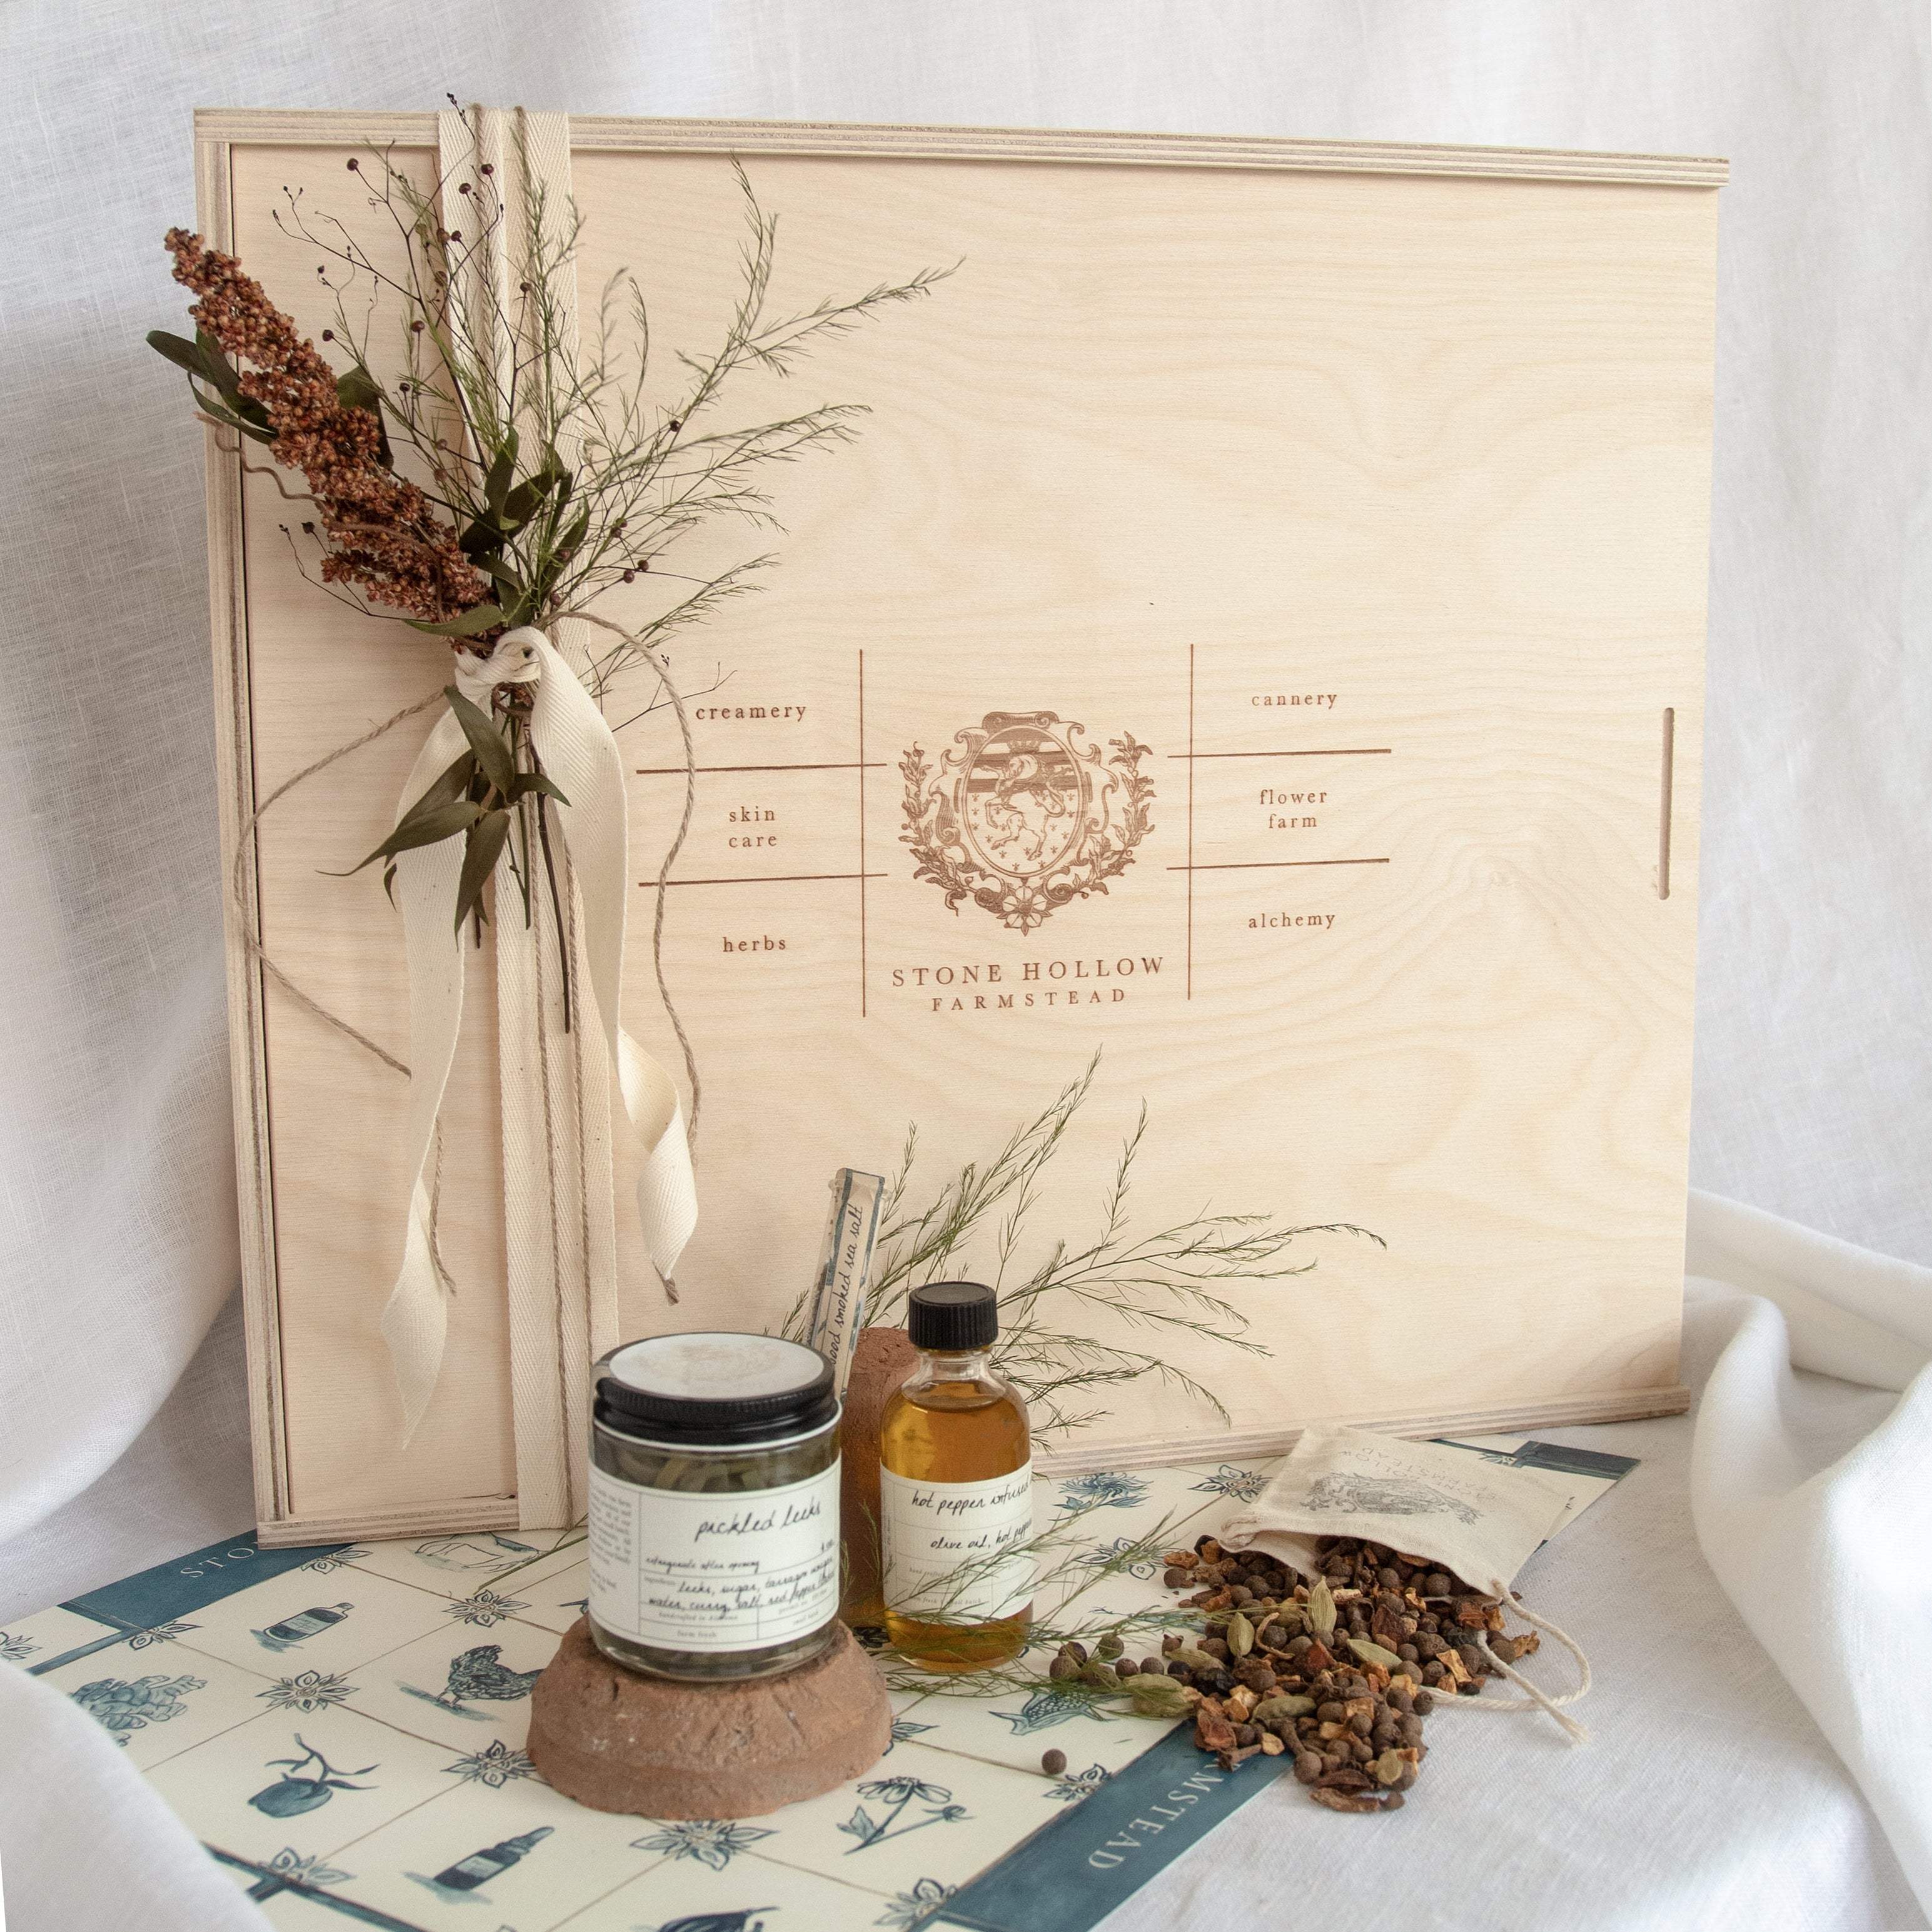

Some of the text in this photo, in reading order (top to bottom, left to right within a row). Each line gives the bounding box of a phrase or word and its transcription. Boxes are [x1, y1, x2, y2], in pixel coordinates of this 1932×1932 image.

[1251, 693, 1337, 710] cannery
[695, 703, 807, 723] creamery
[1259, 789, 1327, 805] flower
[729, 806, 776, 823] skin
[1268, 814, 1317, 830] farm
[728, 834, 777, 849] care
[1248, 912, 1336, 930] alchemy
[722, 935, 787, 953] herbs
[892, 957, 1164, 989] STONE HOLLOW
[932, 989, 1126, 1013] FARMSTEAD
[847, 1202, 863, 1238] salt
[845, 1243, 858, 1270] sea
[832, 1272, 851, 1329] smoked
[912, 1489, 934, 1508] hot
[937, 1498, 986, 1516] pepper
[694, 1510, 775, 1542] pickled
[930, 1536, 963, 1550] olive
[179, 1541, 258, 1579] STO
